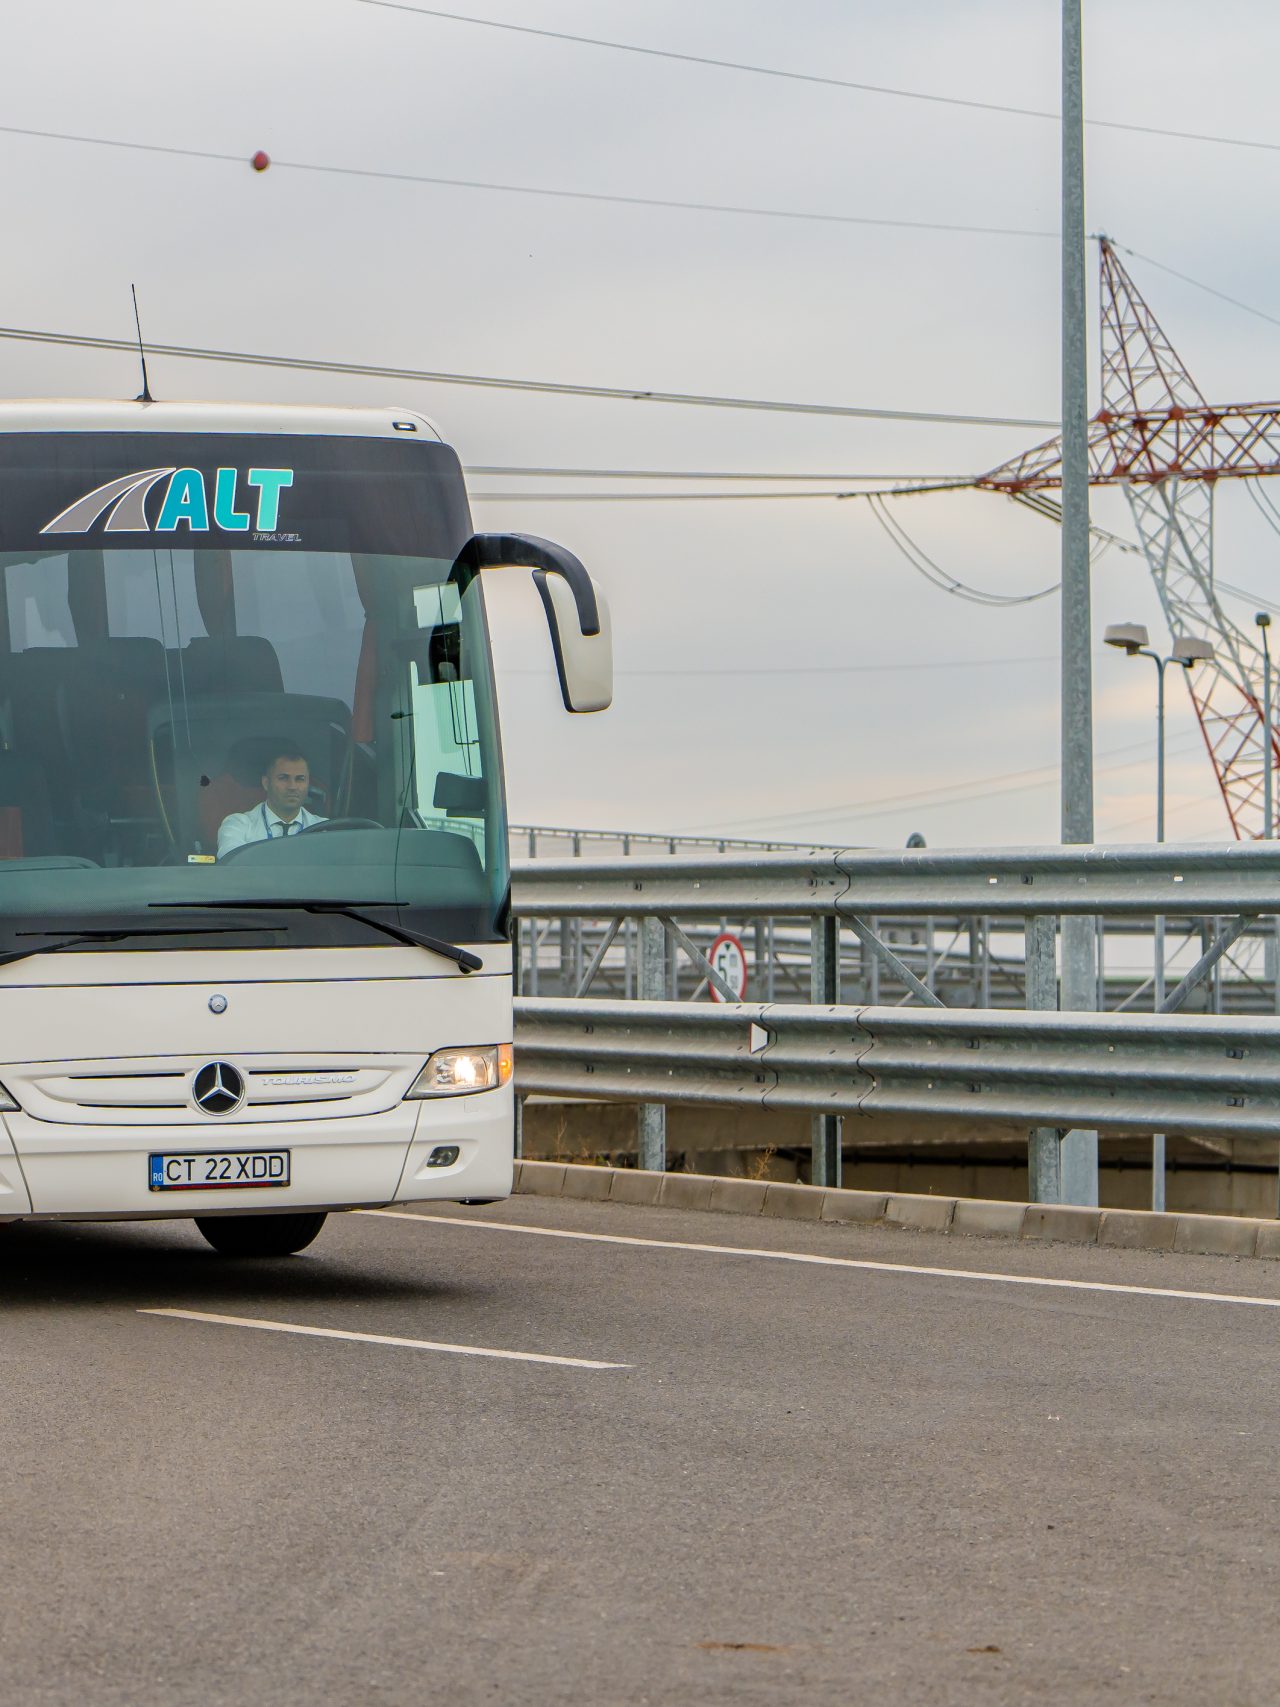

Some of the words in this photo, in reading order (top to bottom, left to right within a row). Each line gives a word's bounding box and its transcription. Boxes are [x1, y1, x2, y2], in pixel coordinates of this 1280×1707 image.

[155, 467, 294, 532] ALT
[252, 532, 302, 542] TRAVEL
[261, 1074, 357, 1086] TOURISMO
[166, 1159, 196, 1181] CT
[205, 1157, 232, 1180] 22
[236, 1155, 284, 1179] XDD
[153, 1172, 163, 1182] RO
